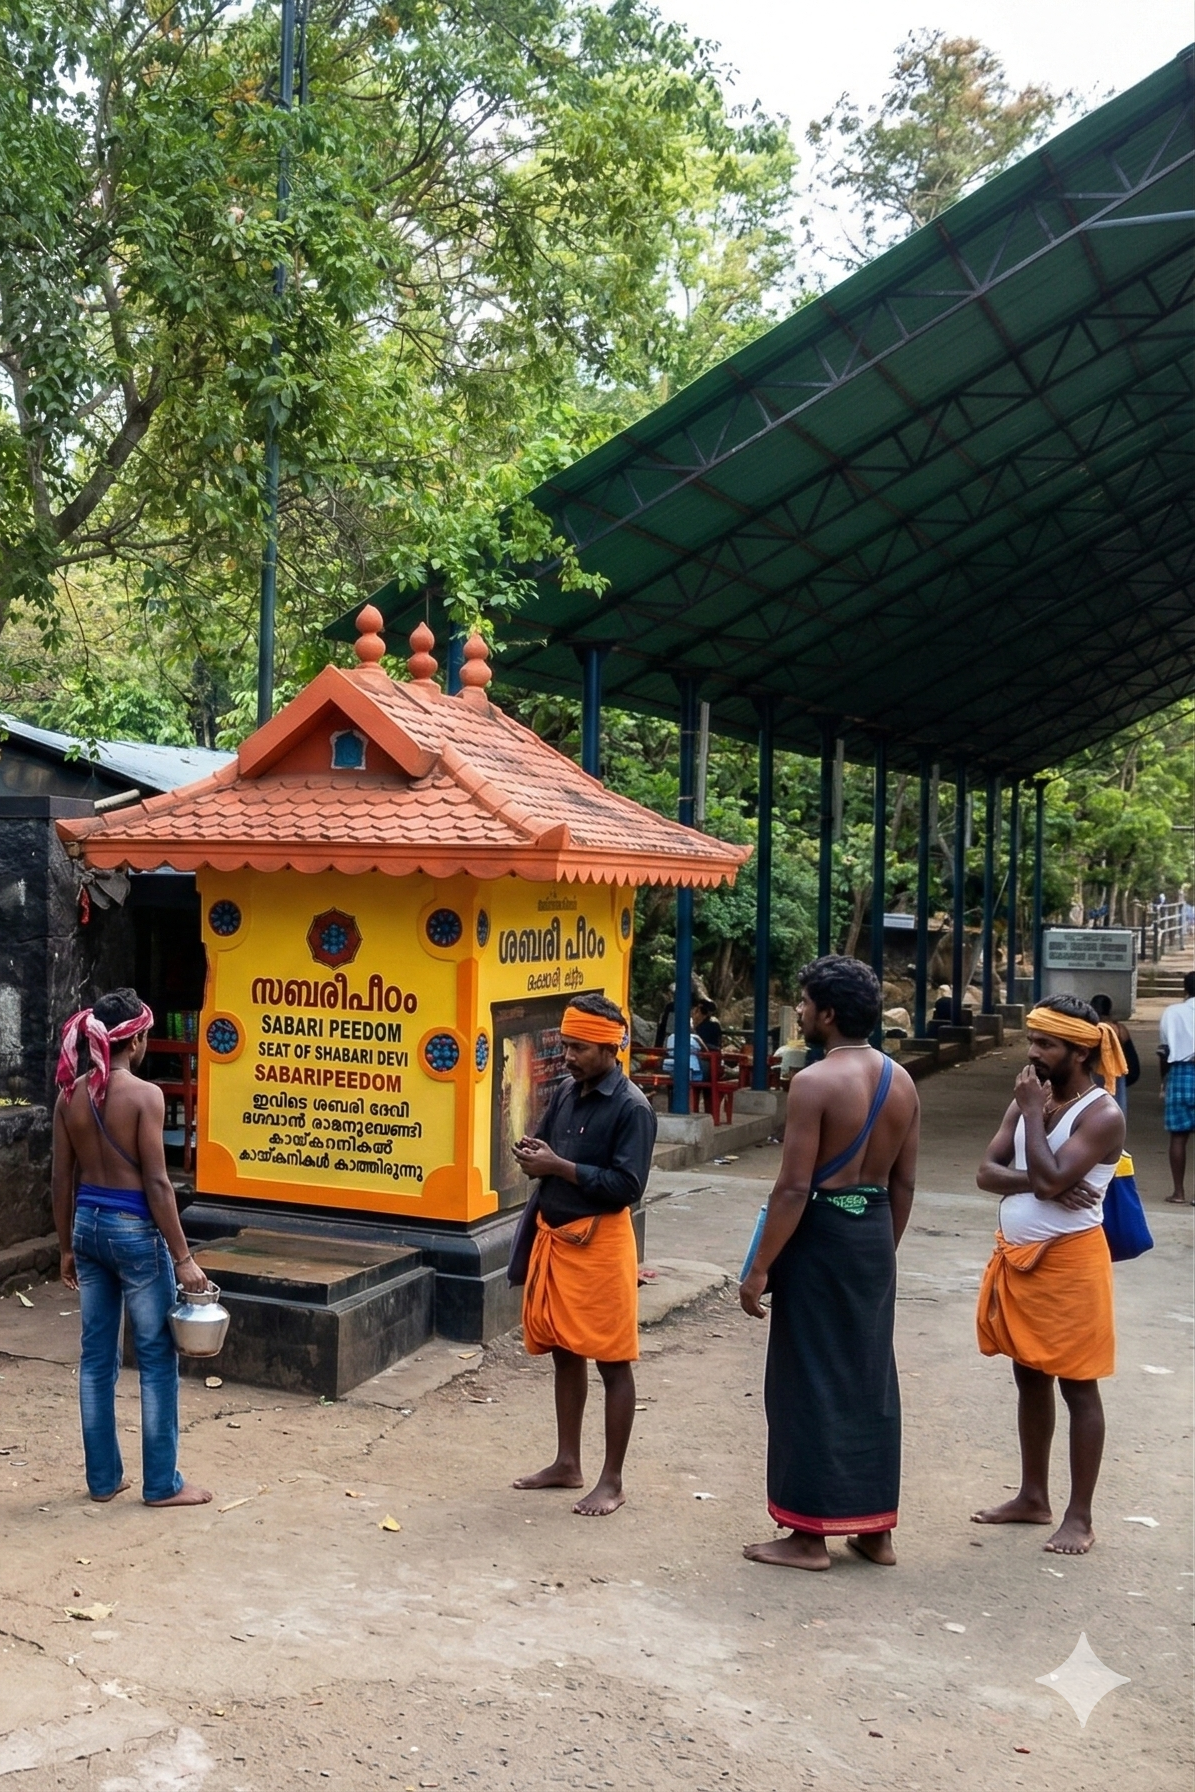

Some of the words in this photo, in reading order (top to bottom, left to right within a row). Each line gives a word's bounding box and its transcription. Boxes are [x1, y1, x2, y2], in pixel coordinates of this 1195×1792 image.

[261, 1013, 324, 1037] SABARI
[329, 1019, 402, 1043] PEEDOM
[258, 1041, 291, 1058] SEAT
[294, 1044, 312, 1059] OF
[314, 1045, 373, 1065] SHABARI
[377, 1050, 409, 1067] DEVI
[254, 1063, 402, 1093] SABARIPEEDOM
